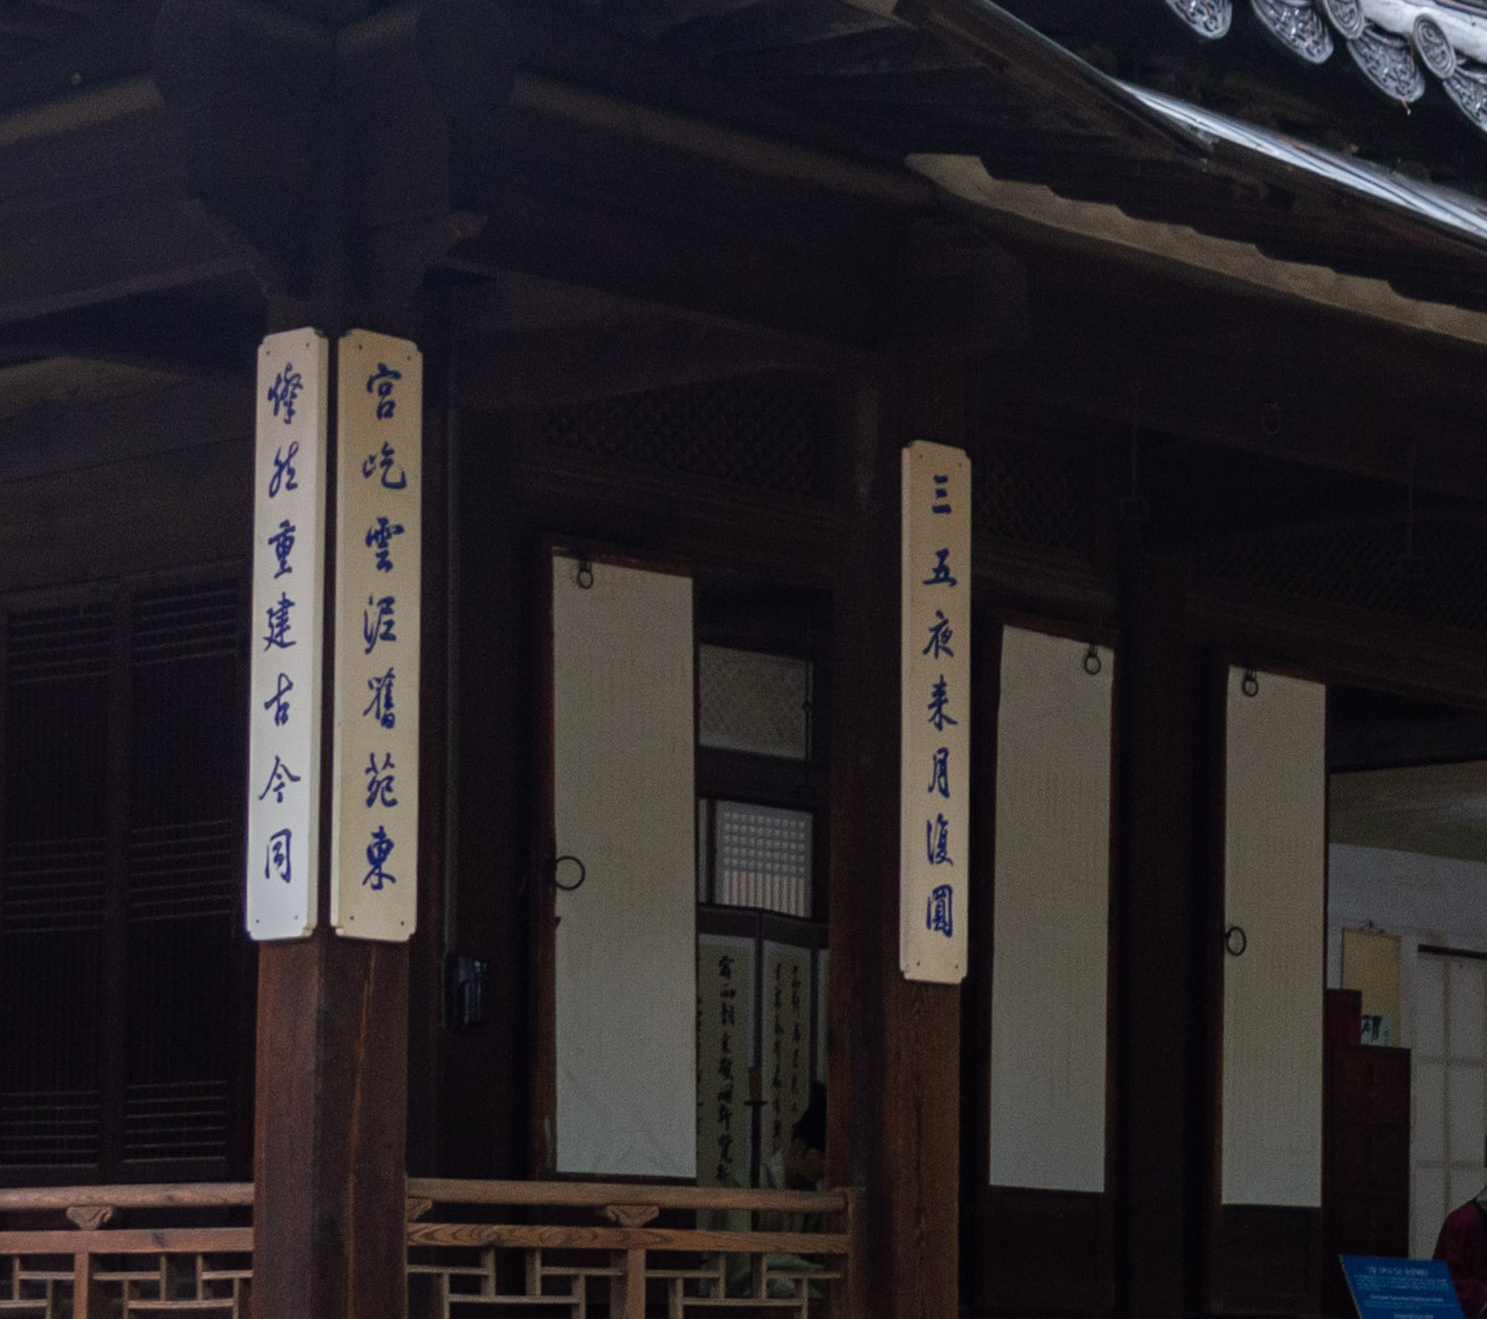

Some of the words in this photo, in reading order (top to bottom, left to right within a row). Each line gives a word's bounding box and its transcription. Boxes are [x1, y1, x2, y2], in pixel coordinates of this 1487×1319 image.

[258, 362, 305, 885] 燦然重建古今同
[922, 475, 959, 939] 三五夜來月復圓
